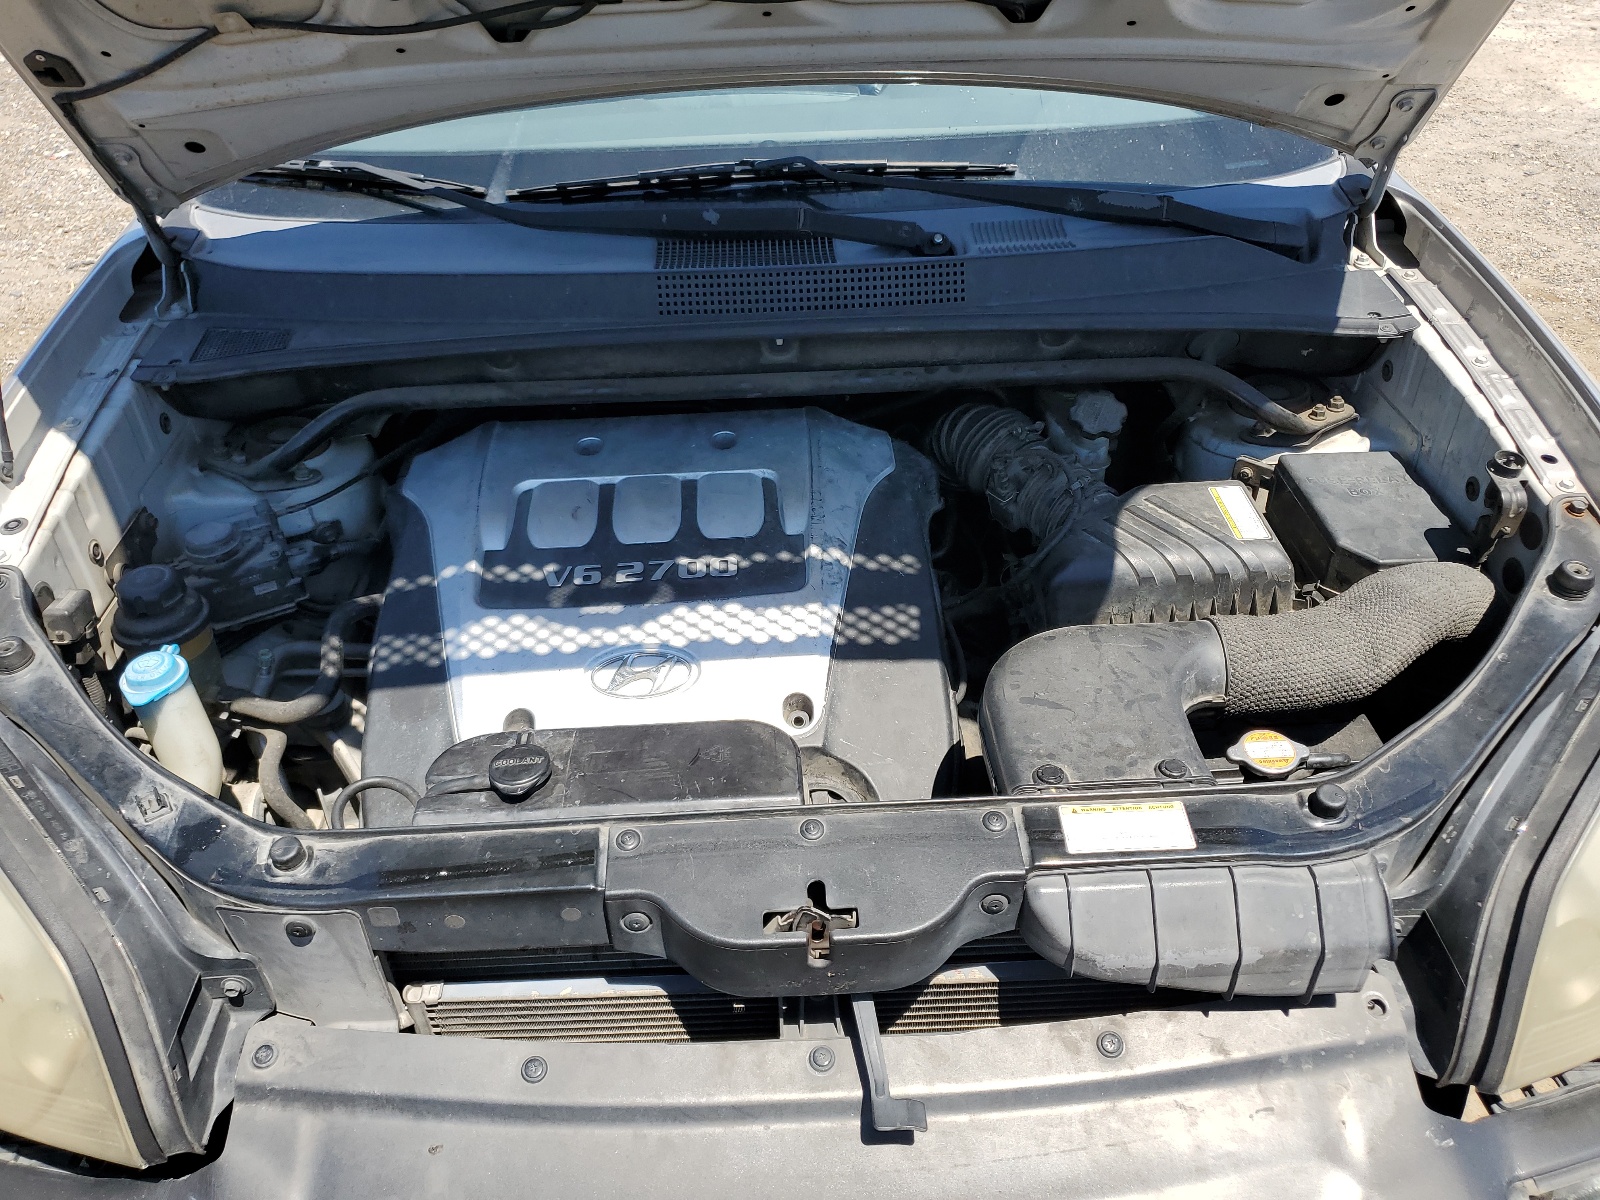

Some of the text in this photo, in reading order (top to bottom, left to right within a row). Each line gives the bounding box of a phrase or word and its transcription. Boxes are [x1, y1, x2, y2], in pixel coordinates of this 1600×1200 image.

[543, 557, 739, 588] V6 2700
[493, 756, 545, 768] COOLANT
